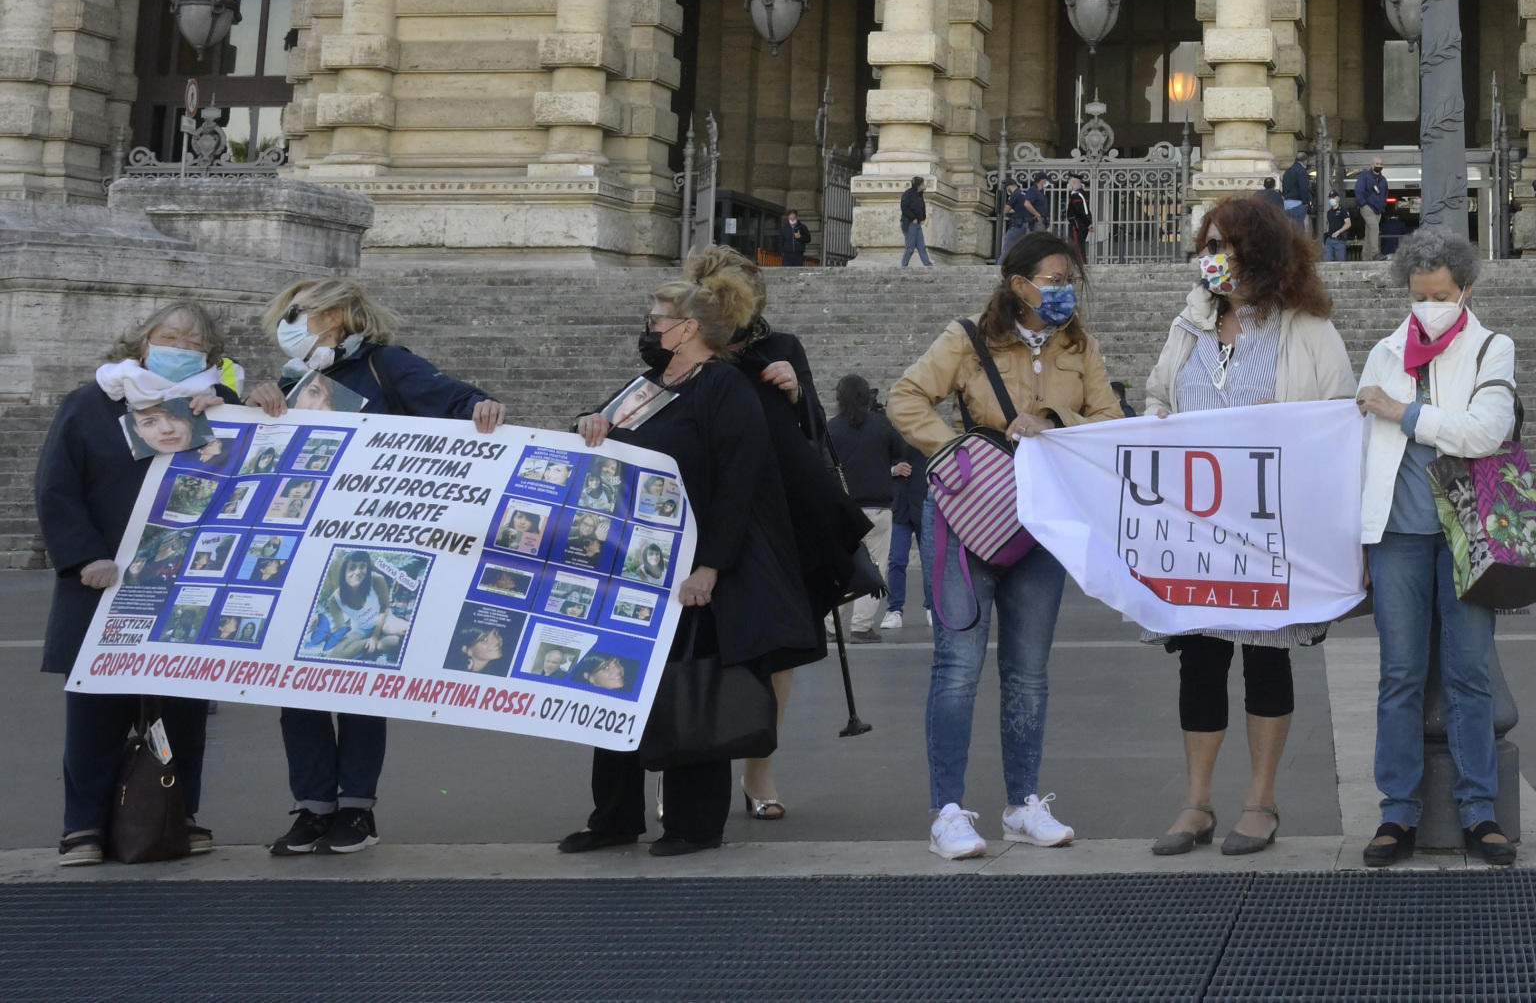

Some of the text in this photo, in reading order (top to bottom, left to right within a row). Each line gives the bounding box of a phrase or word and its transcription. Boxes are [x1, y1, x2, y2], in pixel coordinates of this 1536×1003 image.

[365, 432, 448, 454] MARTINA
[447, 439, 507, 460] ROSSI
[371, 454, 472, 479] LA VITTIMA
[333, 474, 491, 506] NON SI PROCESSA
[1123, 450, 1275, 520] UDI
[354, 499, 448, 522] LA MORTE
[310, 520, 477, 555] NON SI PRESCRIVE
[1126, 548, 1283, 577] DONNE
[1165, 586, 1283, 608] ITALIA
[105, 619, 154, 629] GIUSTIZIA
[99, 633, 143, 644] MARTINA
[90, 652, 146, 676] GRUPPO
[144, 654, 226, 682] VOGLIAMO
[224, 660, 281, 686] VERITA
[278, 665, 295, 688] E
[292, 667, 368, 695] GIUSTIZIA
[369, 673, 405, 699] PER
[403, 678, 480, 708] MARTINA
[540, 696, 636, 735] 07/10/2021
